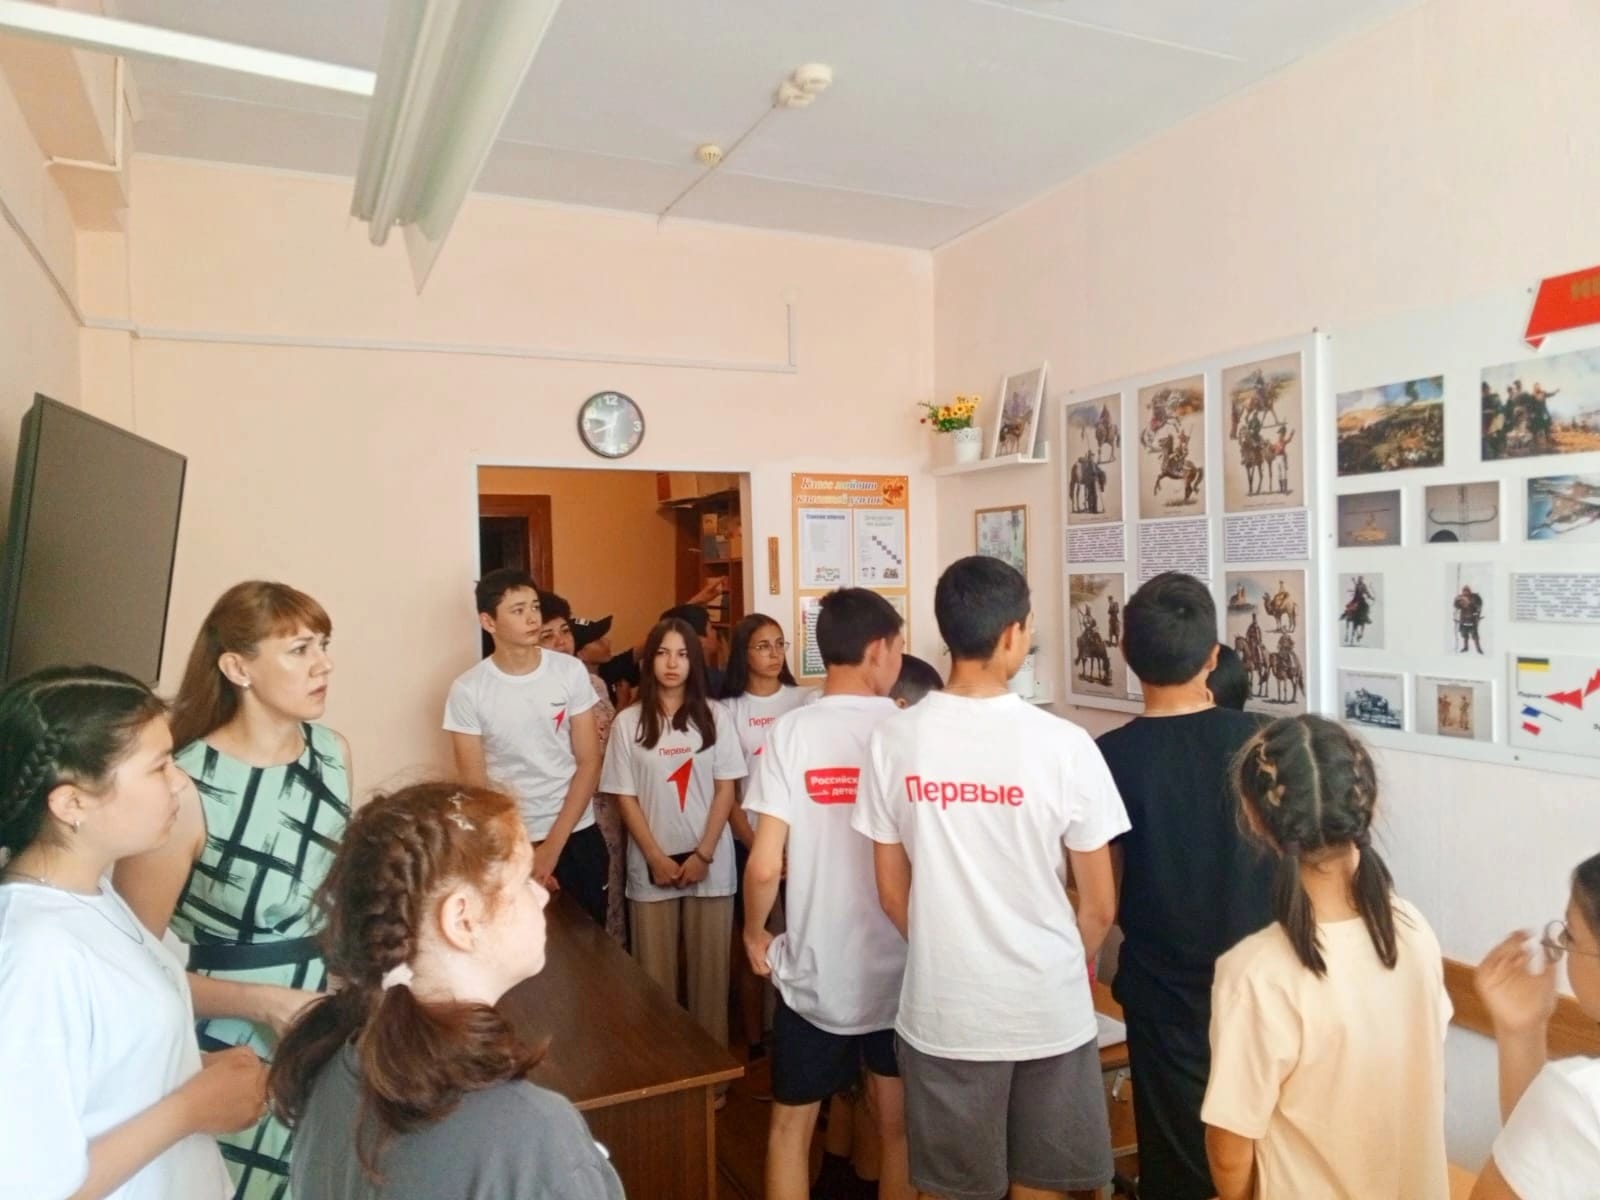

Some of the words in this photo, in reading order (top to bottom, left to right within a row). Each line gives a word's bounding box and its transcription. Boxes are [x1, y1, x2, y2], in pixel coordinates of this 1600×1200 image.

[603, 394, 618, 405] 12
[633, 420, 642, 432] 3
[749, 717, 776, 728] Перв
[905, 776, 1024, 810] Первые
